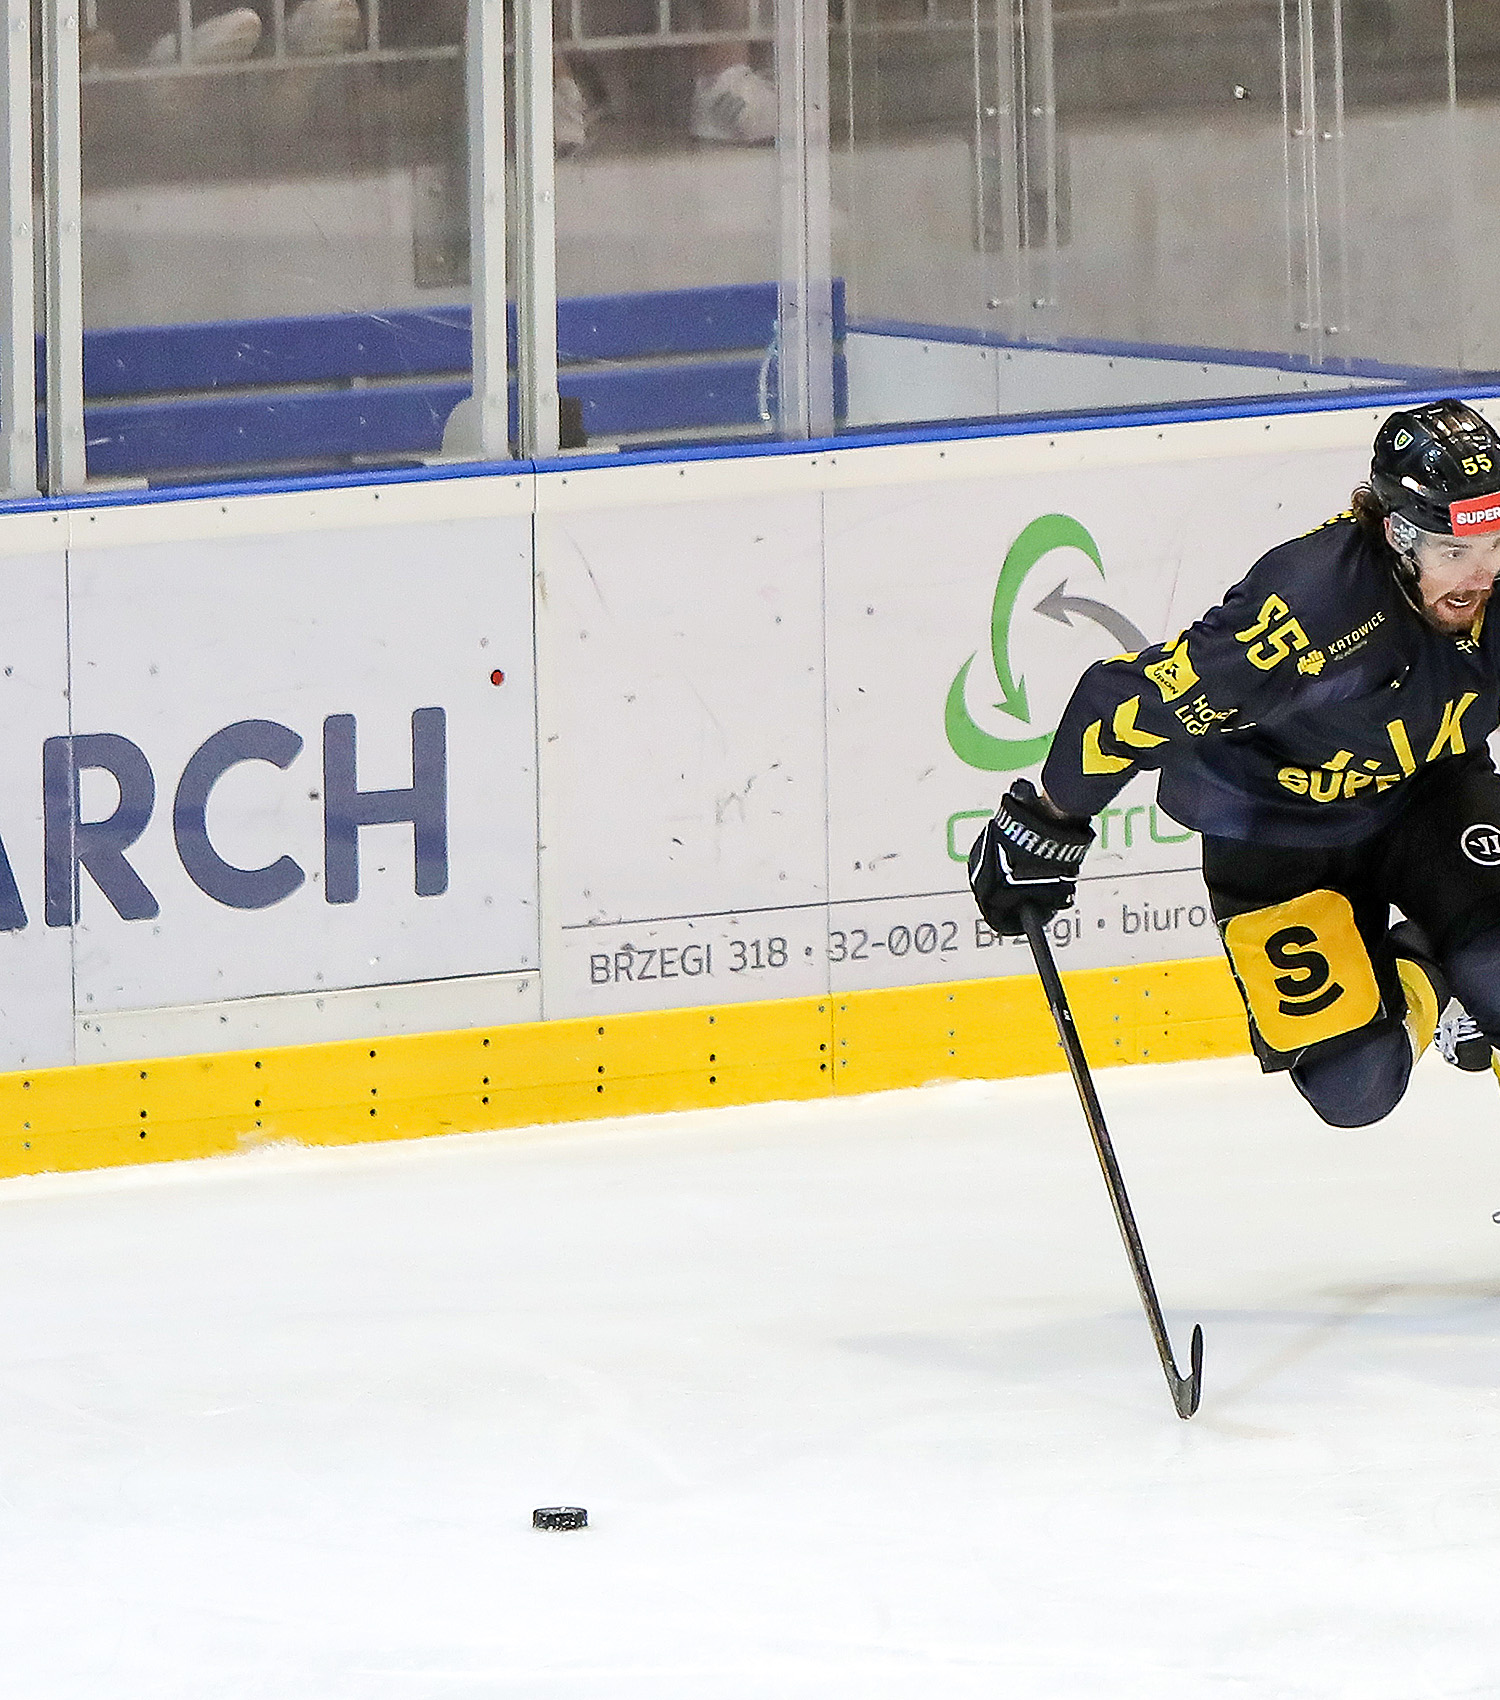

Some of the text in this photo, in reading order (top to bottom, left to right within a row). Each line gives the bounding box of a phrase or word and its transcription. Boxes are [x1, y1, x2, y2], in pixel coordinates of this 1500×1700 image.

[1461, 453, 1493, 476] 55
[1328, 611, 1386, 655] KATOWICE
[1174, 705, 1211, 735] LIGA
[0, 707, 448, 931] RCH
[590, 944, 712, 984] BRZEGI
[729, 937, 788, 972] 318
[829, 921, 959, 962] 32-002
